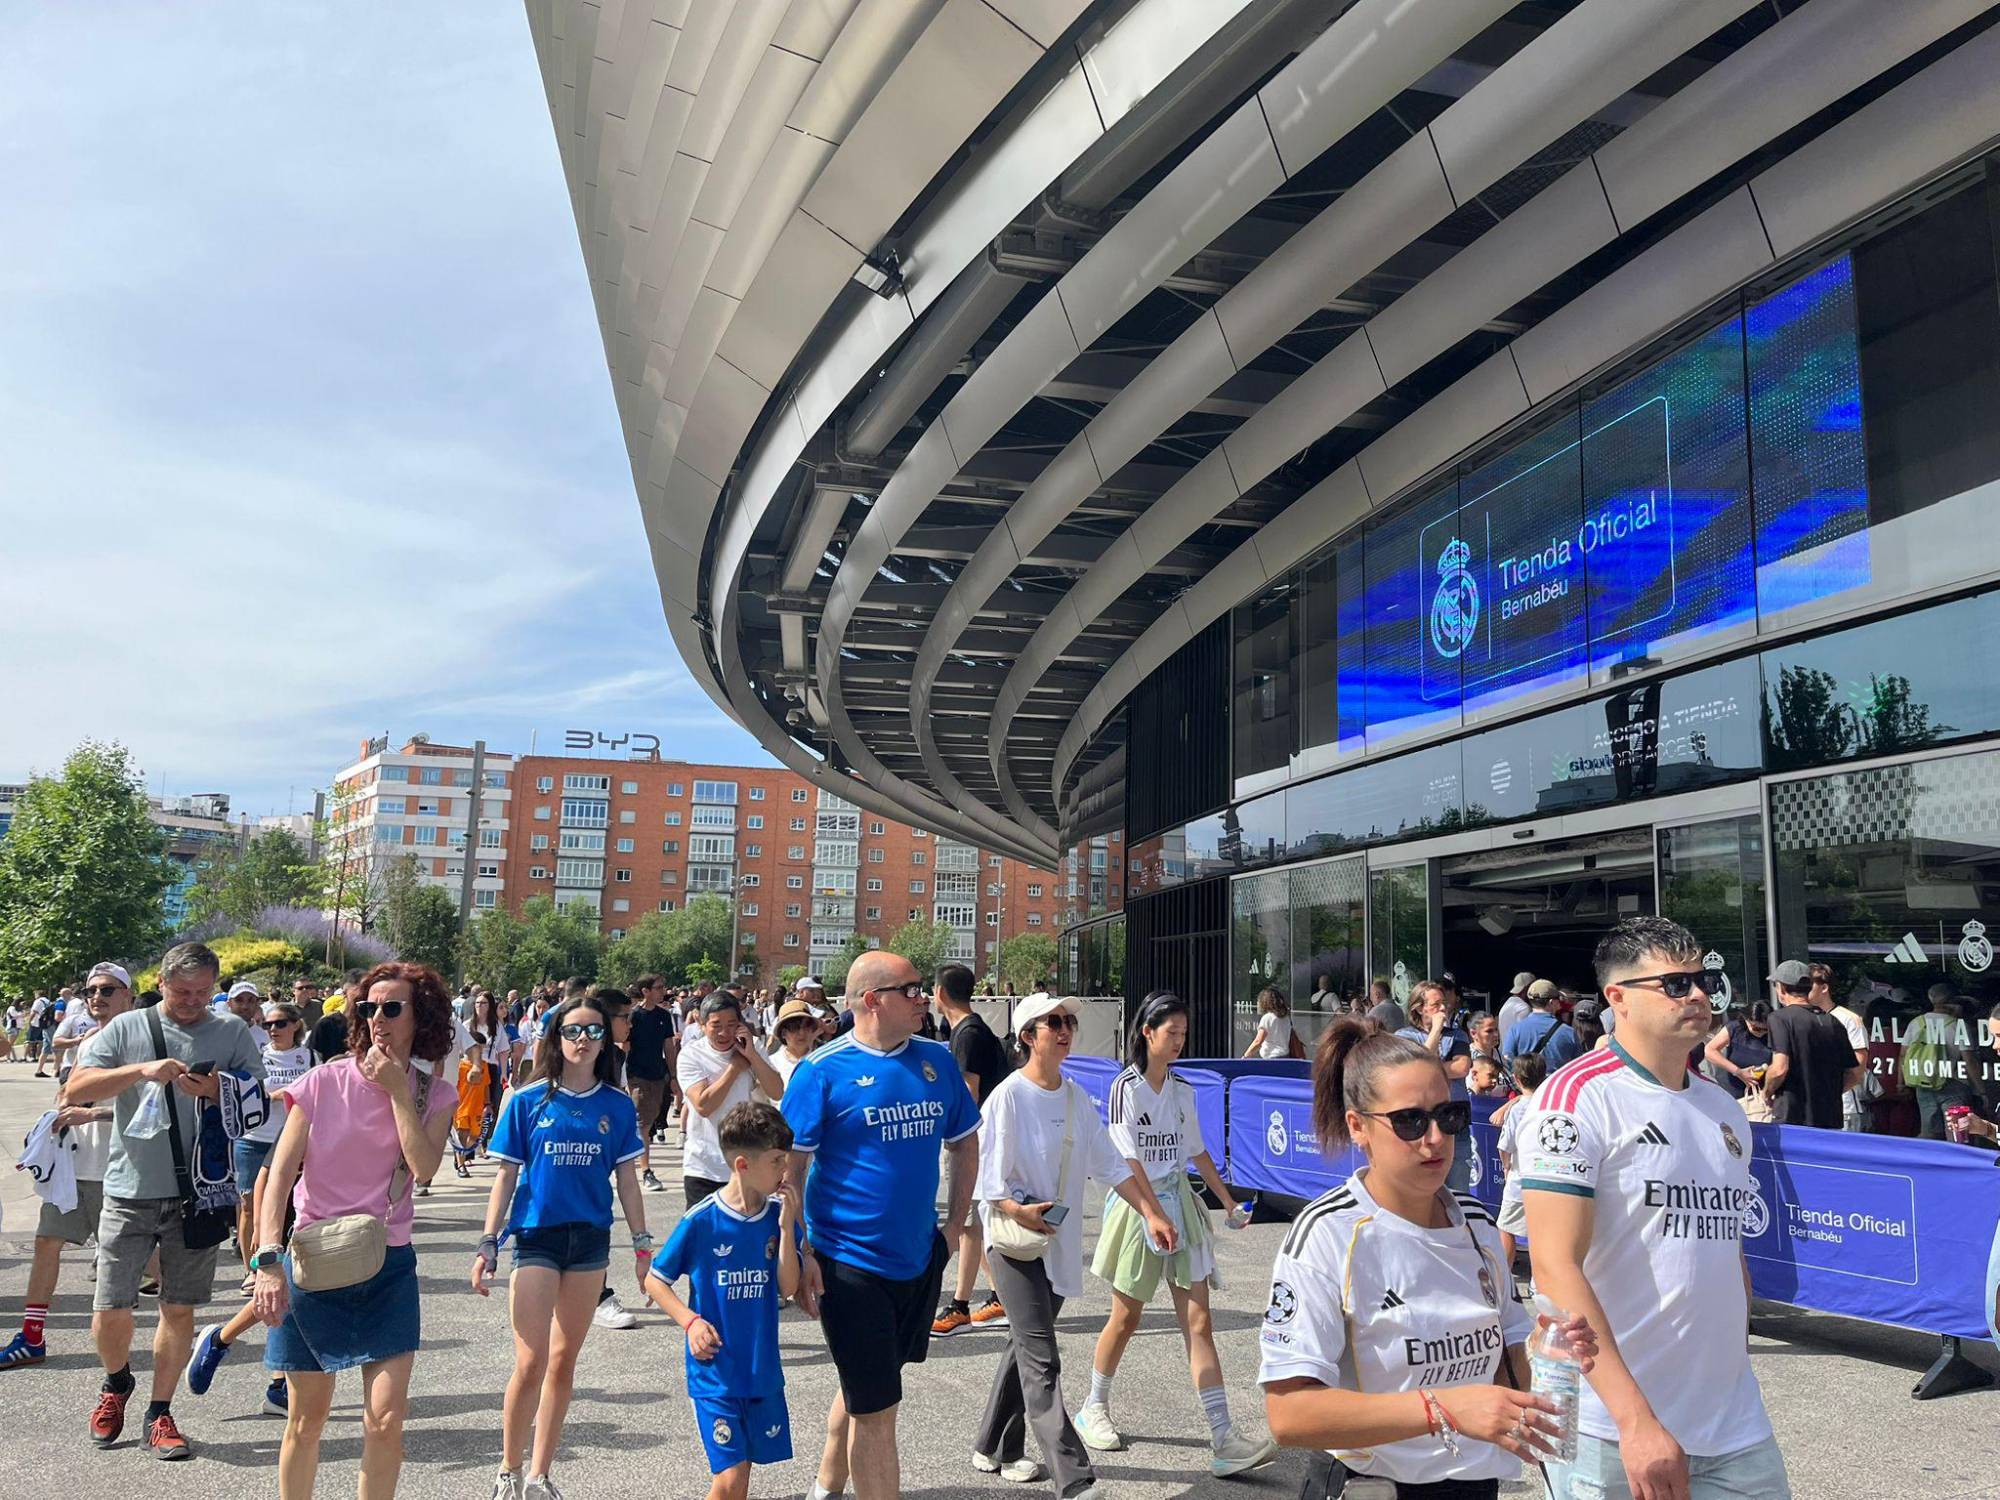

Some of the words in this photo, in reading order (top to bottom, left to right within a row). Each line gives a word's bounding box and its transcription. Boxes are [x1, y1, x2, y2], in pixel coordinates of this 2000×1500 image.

[1498, 538, 1572, 590] Tienda
[1578, 489, 1656, 554] Oficial
[1501, 578, 1569, 620] Bernabéu
[564, 729, 661, 753] BYD
[1925, 1017, 1995, 1048] MAD
[1908, 1058, 1967, 1080] HOME
[863, 1099, 944, 1126] Emirates
[882, 1124, 898, 1142] FLY
[902, 1119, 935, 1139] BETTER
[1294, 1130, 1320, 1143] Tiend
[544, 1139, 602, 1155] Emirates
[1144, 1148, 1157, 1162] FLY
[1159, 1147, 1178, 1162] BETT
[553, 1154, 566, 1166] FLY
[566, 1154, 593, 1166] BETTER
[1643, 1179, 1749, 1212] Emirates
[1663, 1213, 1691, 1238] FLY
[1697, 1215, 1739, 1240] BETTER
[1785, 1202, 1845, 1229] Tienda
[1848, 1212, 1906, 1238] Oficial
[1788, 1224, 1843, 1244] Bernabéu
[727, 1286, 742, 1300] FLY
[742, 1284, 764, 1299] BETT
[1404, 1323, 1501, 1367] Emirates
[1419, 1366, 1444, 1386] FLY
[1445, 1355, 1491, 1382] BETTER
